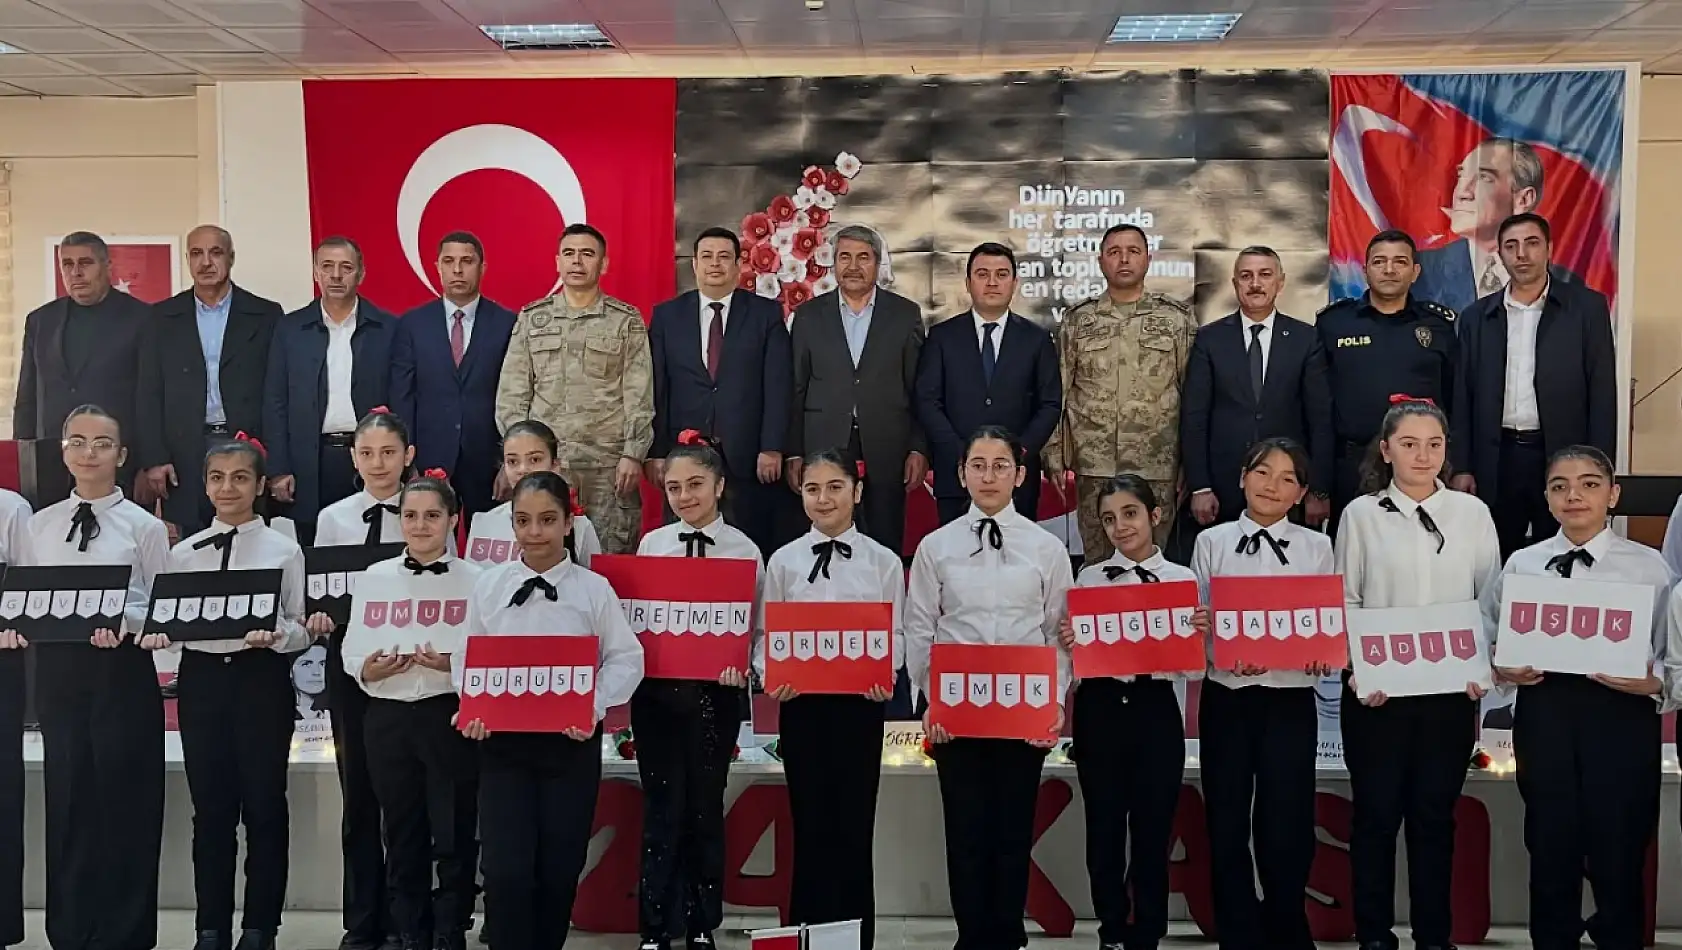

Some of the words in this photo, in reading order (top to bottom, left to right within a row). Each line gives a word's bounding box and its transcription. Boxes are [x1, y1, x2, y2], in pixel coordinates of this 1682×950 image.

[1009, 208, 1046, 229] her
[1016, 258, 1045, 279] an
[1021, 281, 1048, 298] en
[475, 543, 516, 557] SE
[312, 577, 356, 593] RE
[6, 595, 120, 610] GÜVEN
[160, 598, 269, 616] SABIR
[370, 605, 462, 621] UMUT
[1519, 609, 1623, 633] IŞIK
[1080, 613, 1191, 635] DEĞER
[1222, 615, 1335, 630] SAYGI
[773, 633, 884, 653] ÖRNEK
[470, 671, 588, 689] DÜRÜST
[948, 681, 1043, 698] EMEK
